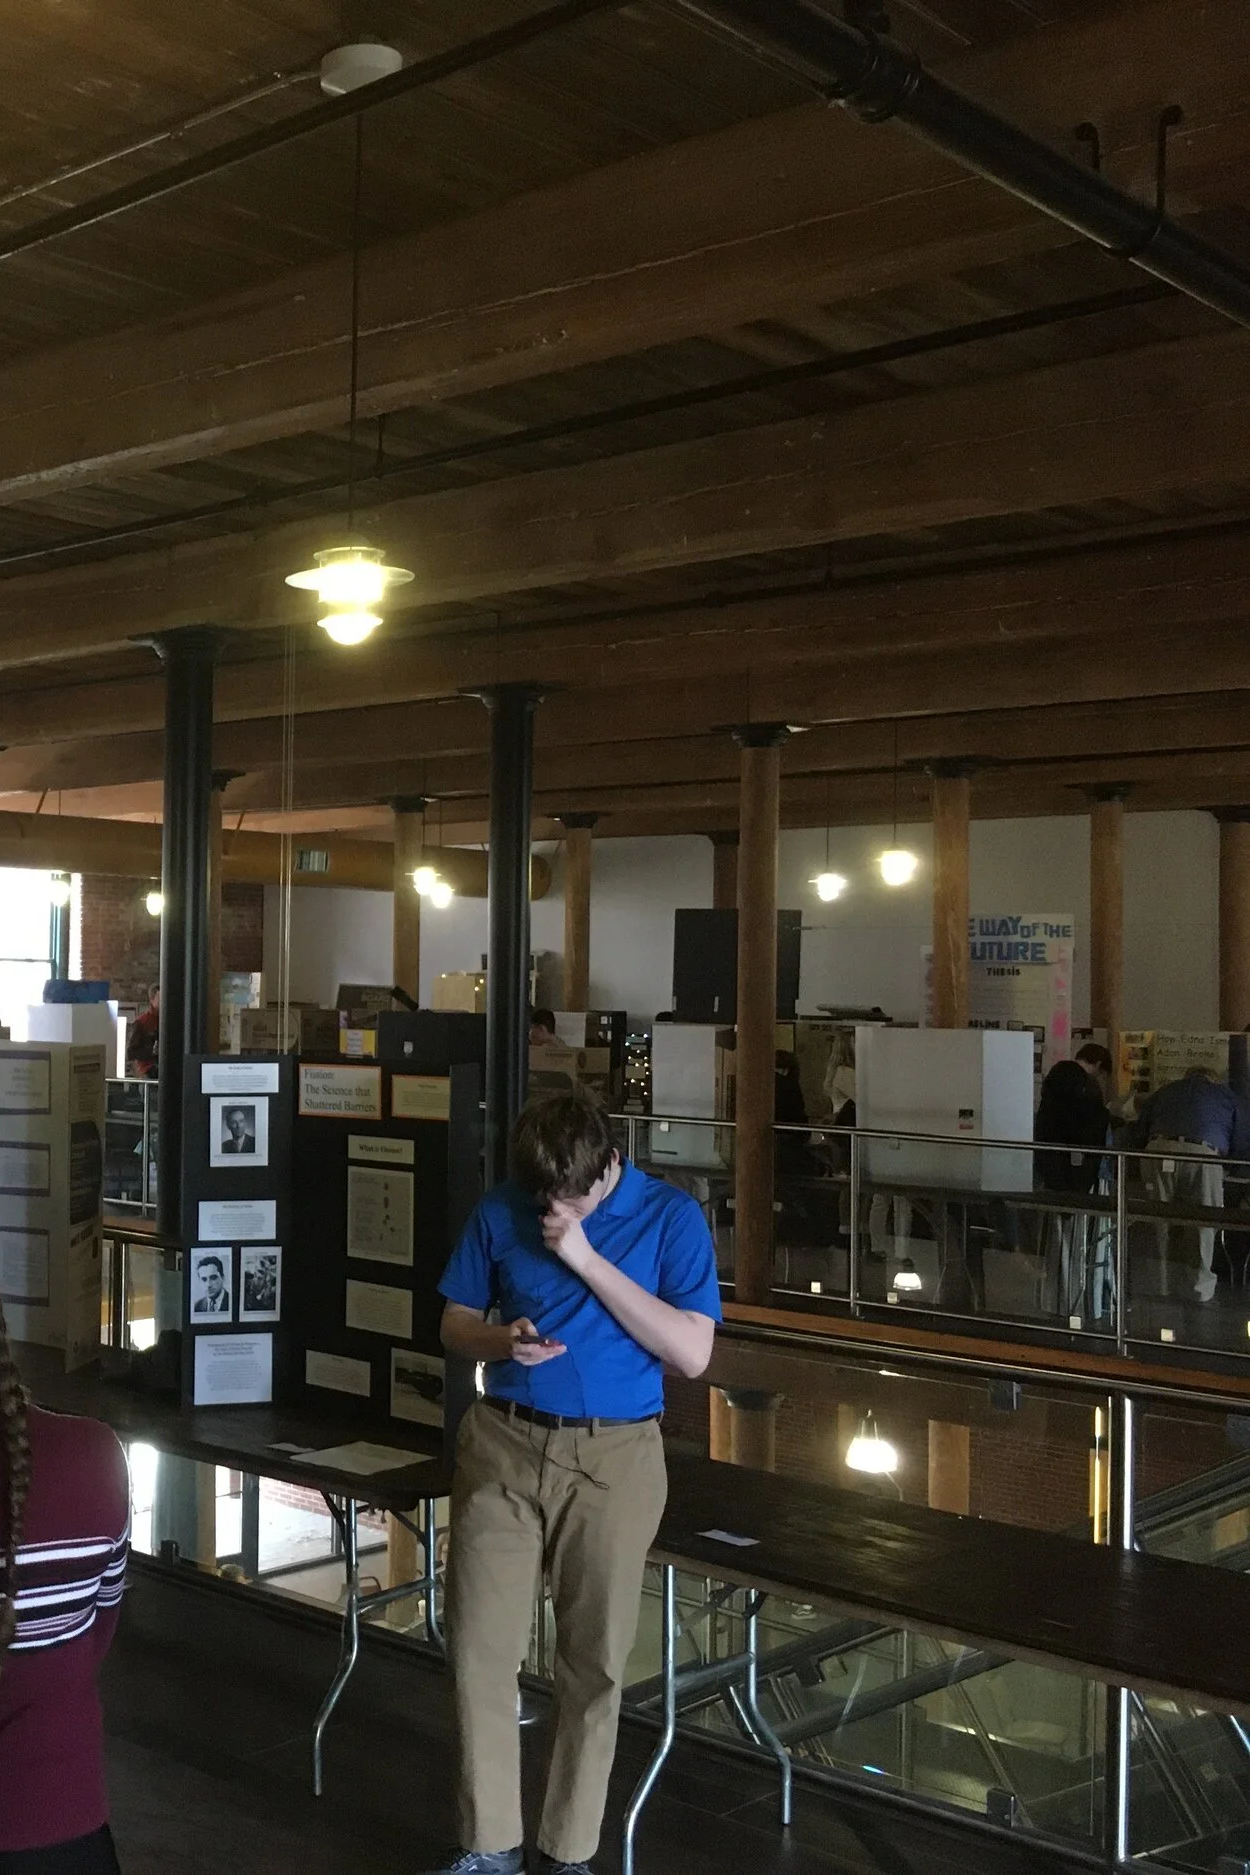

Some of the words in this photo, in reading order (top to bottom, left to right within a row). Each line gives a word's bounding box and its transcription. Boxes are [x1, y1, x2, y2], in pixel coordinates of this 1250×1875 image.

[979, 916, 1021, 936] WAY
[1020, 922, 1041, 938] OF
[1042, 922, 1072, 938] THE
[969, 941, 1047, 961] UTURE
[304, 1084, 320, 1095] The
[322, 1085, 352, 1097] Science
[355, 1087, 371, 1097] that
[304, 1099, 341, 1111] Shattered
[344, 1101, 377, 1113] Barriers
